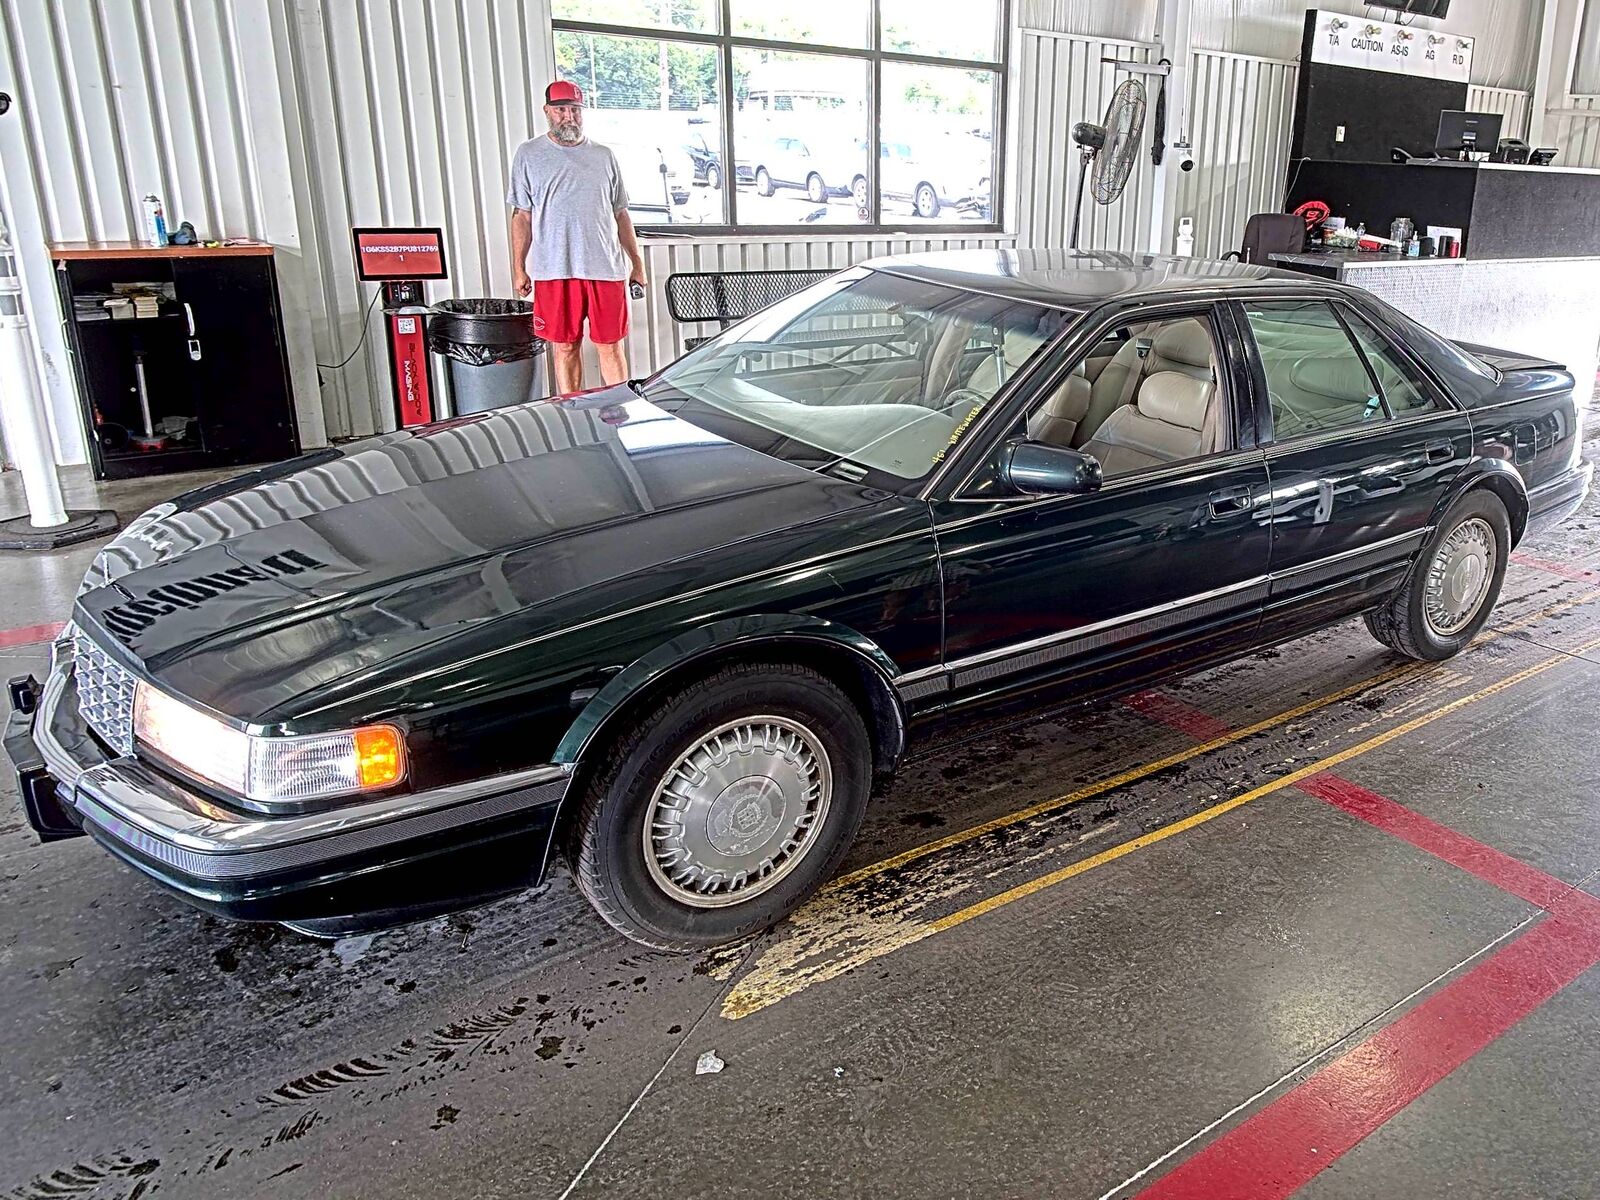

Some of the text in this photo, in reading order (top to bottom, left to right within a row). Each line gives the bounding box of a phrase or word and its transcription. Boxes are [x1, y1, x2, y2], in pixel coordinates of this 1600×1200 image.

[1328, 34, 1340, 46] T/A
[1351, 38, 1384, 53] CAUTION
[1390, 44, 1409, 57] AS-IS
[1425, 50, 1435, 60] AG
[399, 254, 404, 262] 1
